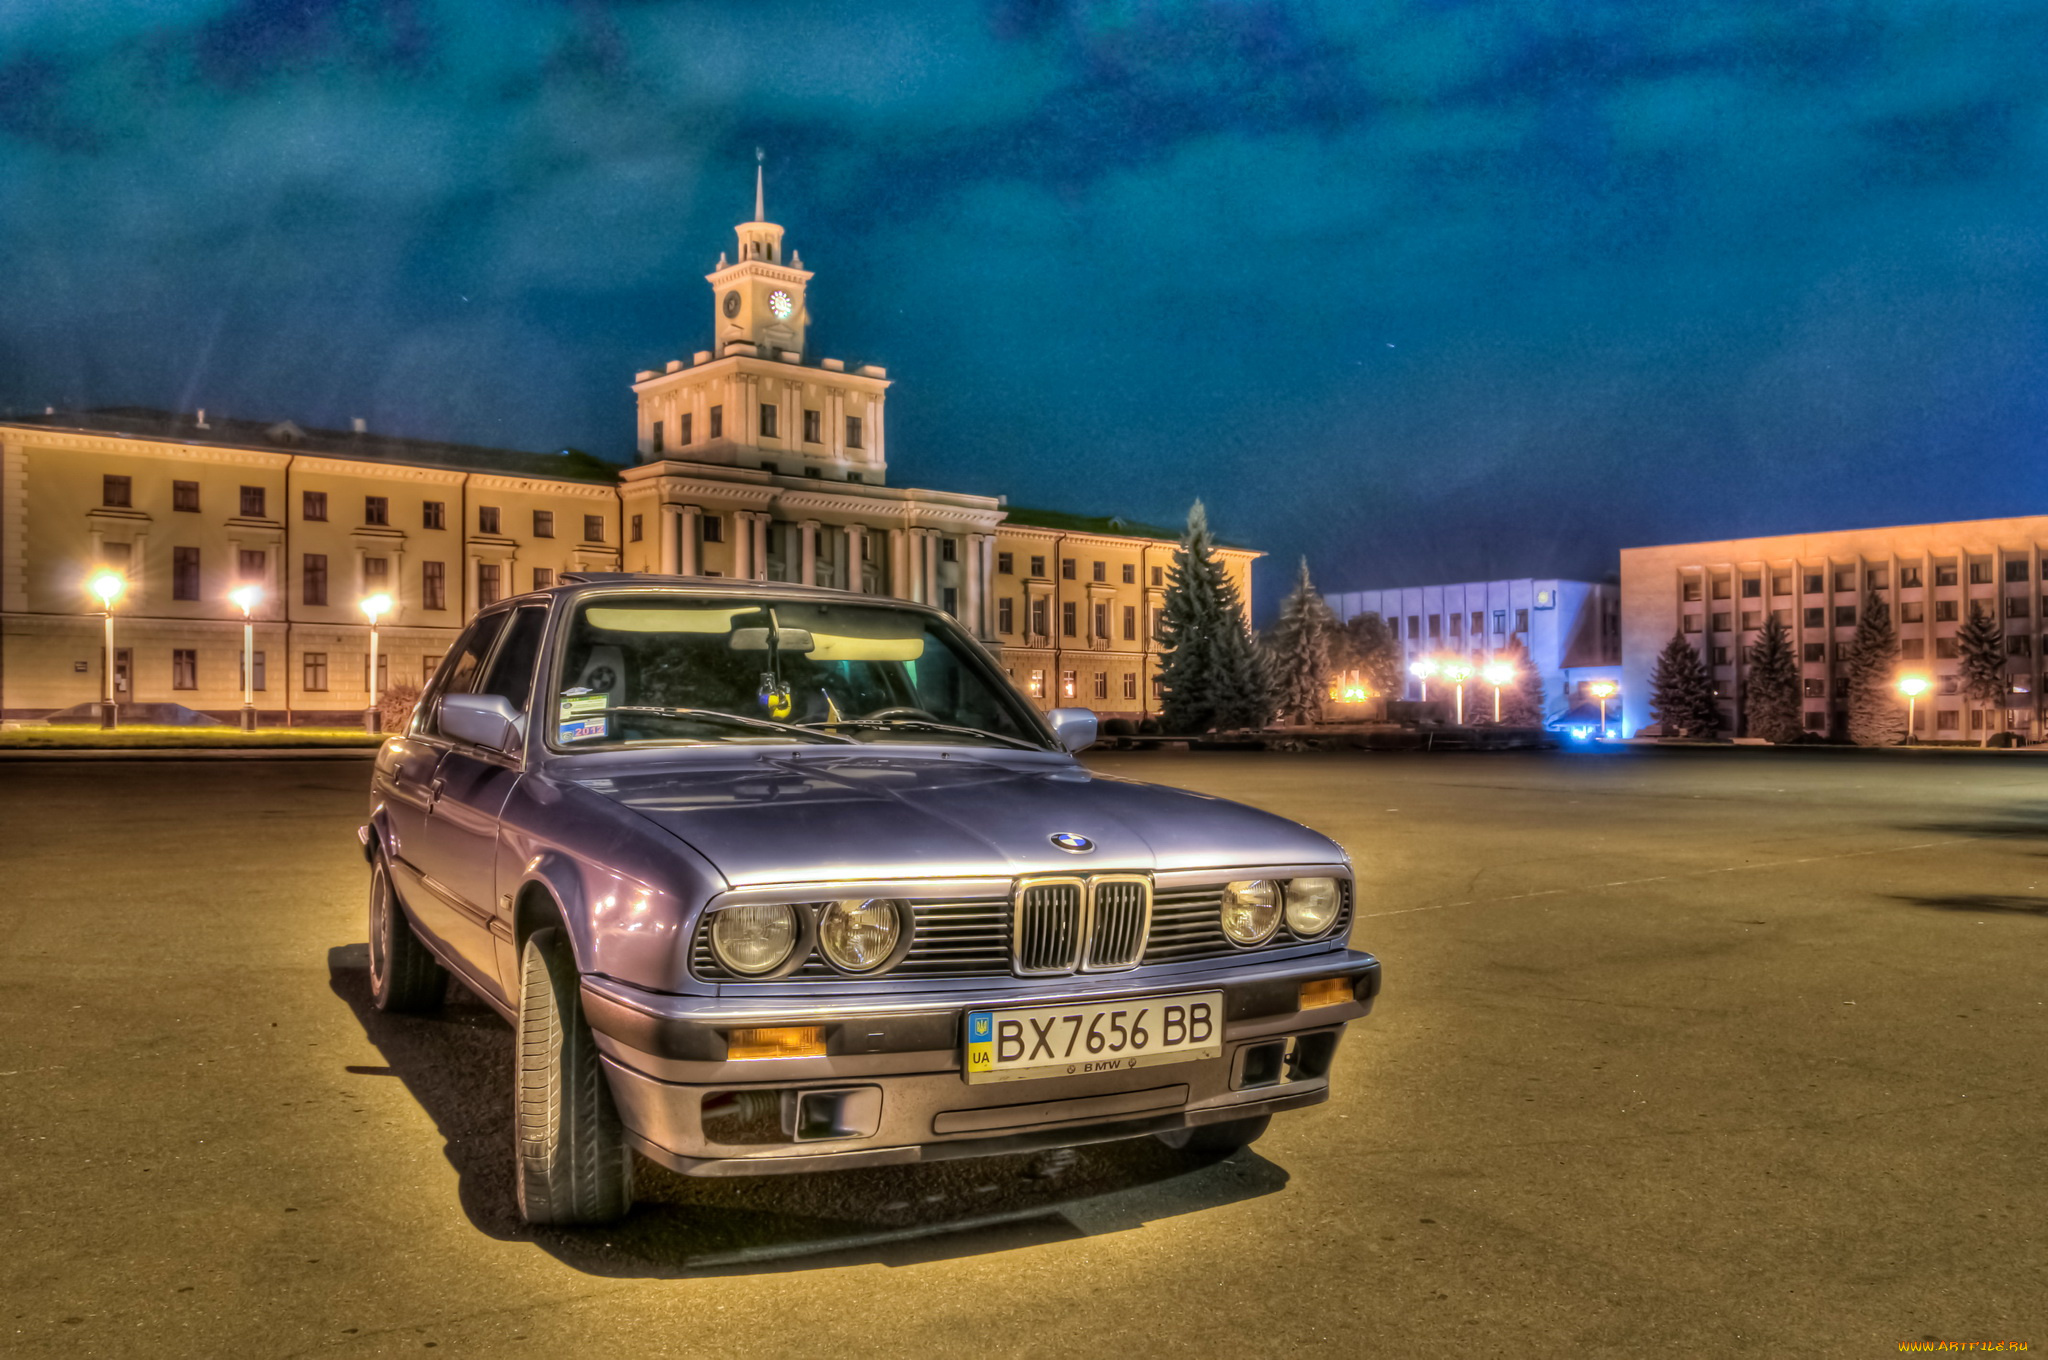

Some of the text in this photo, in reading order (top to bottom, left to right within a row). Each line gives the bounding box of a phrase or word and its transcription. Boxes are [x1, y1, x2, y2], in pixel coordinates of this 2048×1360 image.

[575, 726, 604, 736] 2012
[1163, 1002, 1213, 1047] BB
[972, 1051, 990, 1064] UA
[1084, 1060, 1121, 1073] BMW
